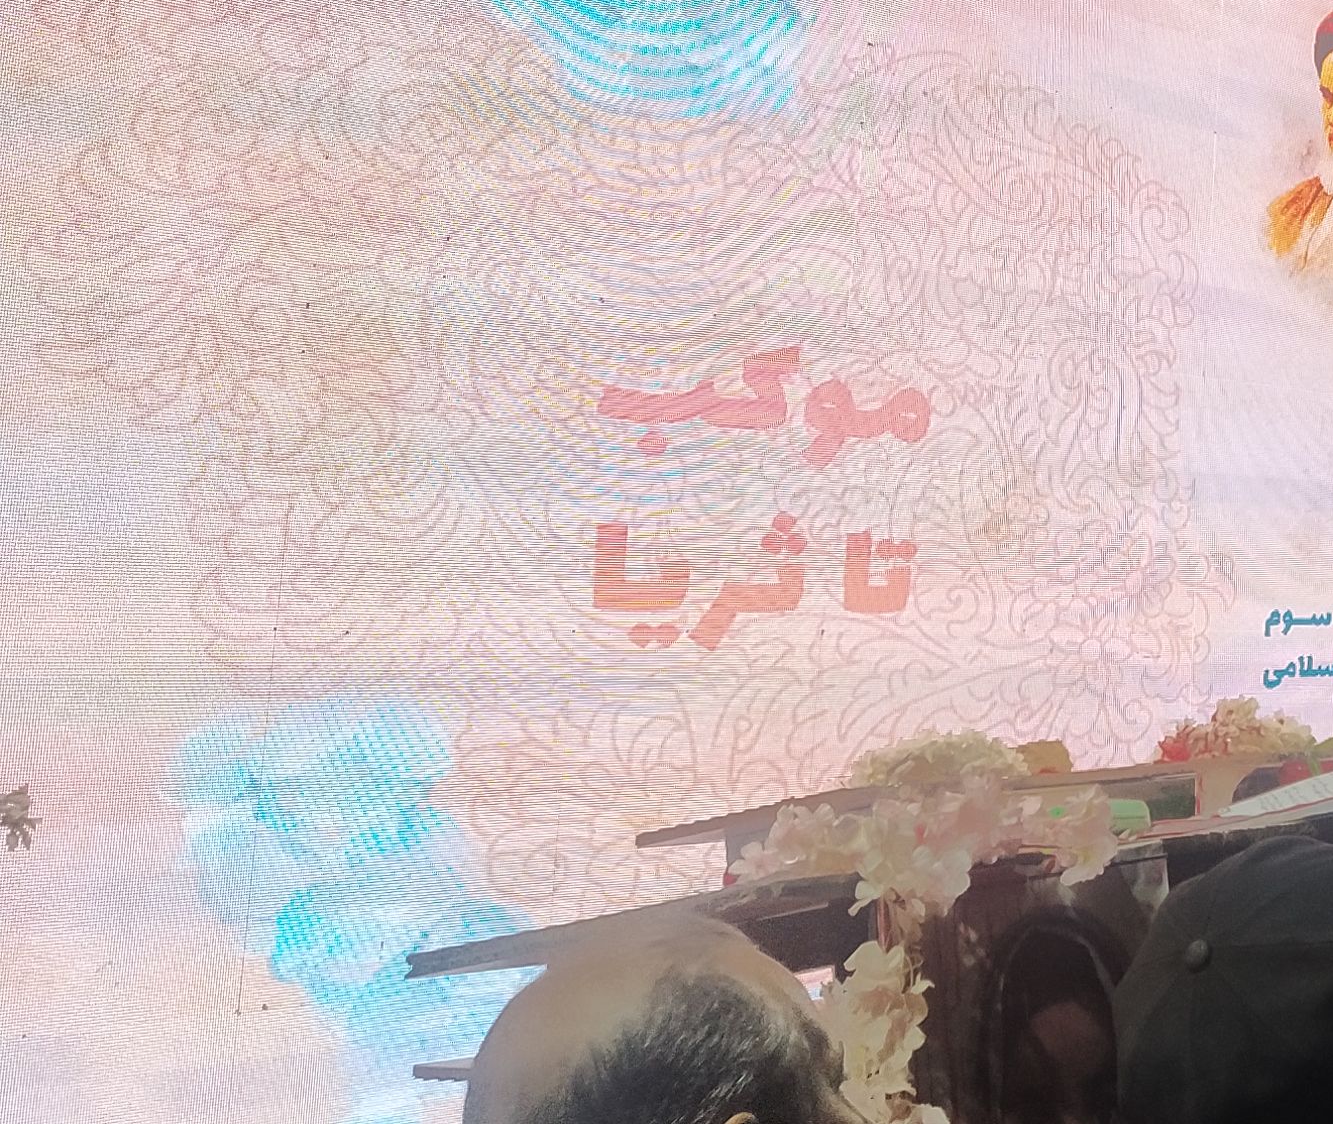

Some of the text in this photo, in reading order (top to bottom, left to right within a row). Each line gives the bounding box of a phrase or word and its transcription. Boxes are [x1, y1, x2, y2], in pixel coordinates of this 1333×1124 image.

[597, 345, 932, 468] موکب
[593, 511, 918, 652] تا ثریا
[1264, 609, 1333, 636] سوم
